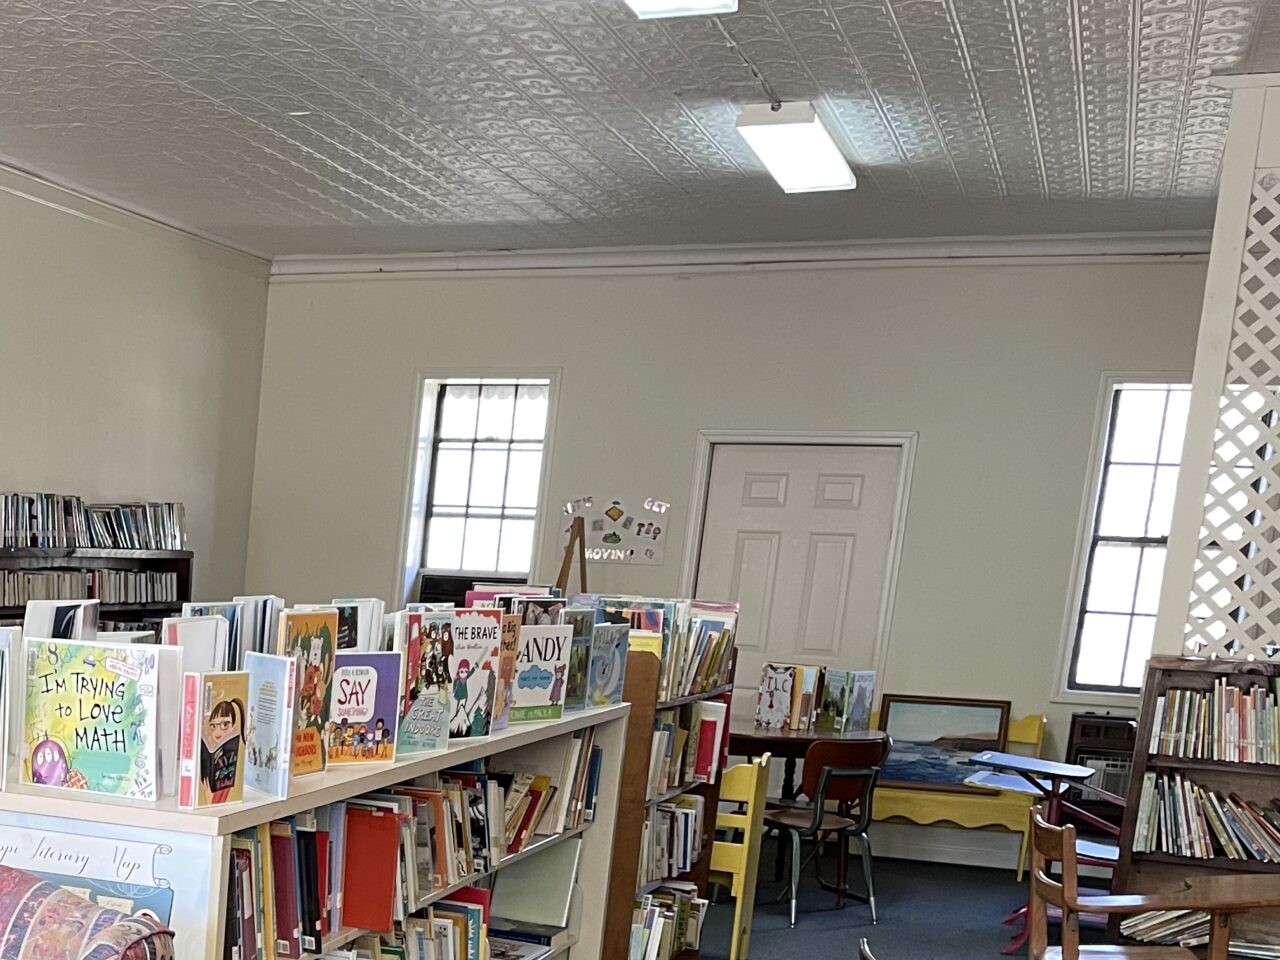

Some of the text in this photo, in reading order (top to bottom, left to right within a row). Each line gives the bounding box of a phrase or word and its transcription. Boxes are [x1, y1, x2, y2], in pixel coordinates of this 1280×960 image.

[643, 498, 671, 514] GET
[455, 626, 498, 640] THE BRAVE
[519, 636, 567, 663] ANDY
[71, 672, 126, 701] TRYING
[337, 679, 371, 707] SAY
[54, 702, 73, 719] to
[420, 697, 435, 708] THE
[411, 708, 444, 723] GREAT
[403, 722, 442, 738] INDOORS
[30, 836, 90, 875] Literary
[112, 845, 142, 881] Map
